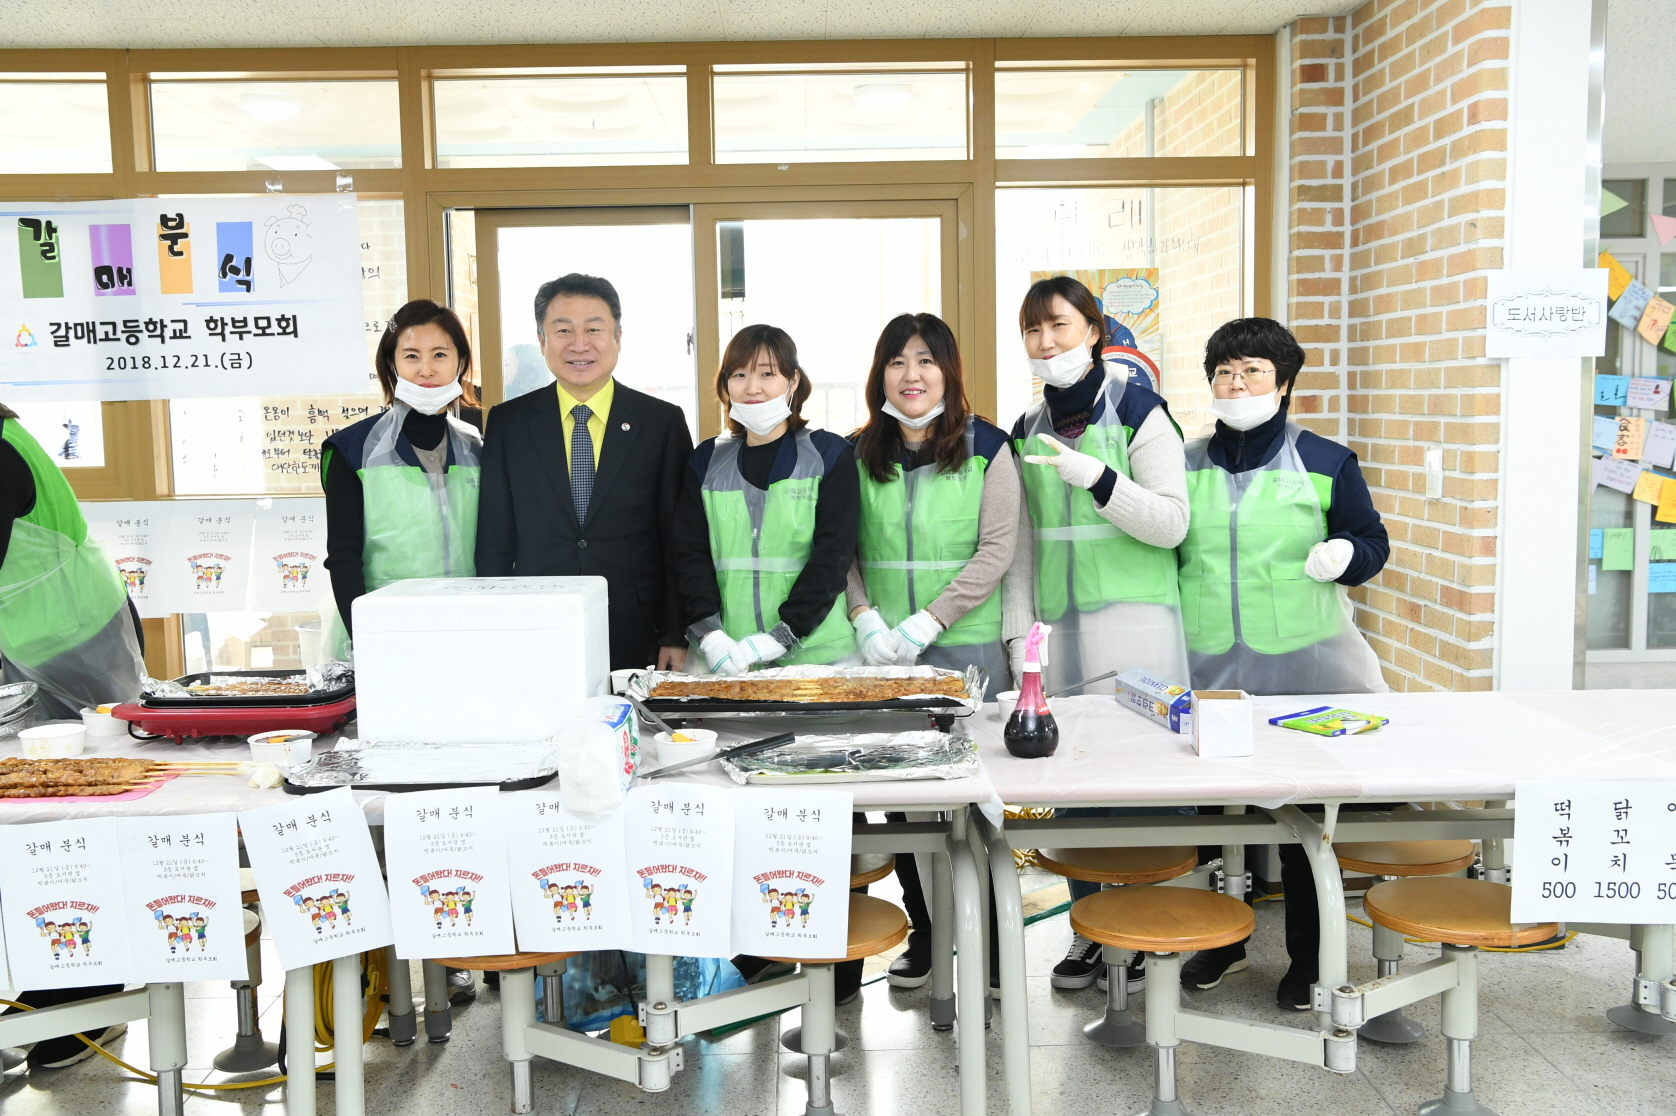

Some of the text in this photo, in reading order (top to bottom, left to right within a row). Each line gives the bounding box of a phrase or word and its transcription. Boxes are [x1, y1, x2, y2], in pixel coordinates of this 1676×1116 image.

[1507, 306, 1586, 322] 도서사랑반
[49, 314, 299, 347] 갈매고등학교 학부모회
[105, 351, 253, 371] 2018.12.21.(금)
[263, 406, 290, 421] 온몸이
[416, 805, 473, 822] 갈매 분식
[535, 802, 560, 816] 갈매
[650, 800, 704, 816] 갈매 분식
[764, 807, 820, 822] 갈매 분식
[272, 810, 331, 836] 갈매 분식
[147, 832, 204, 848] 갈매 분식
[1551, 799, 1573, 874] 떡볶이
[1608, 798, 1633, 874] 닭꼬치
[26, 837, 86, 856] 갈매 분식
[412, 869, 484, 887] 돈들어왔다! 지르자!!
[531, 862, 602, 880] 돈들어왔다! 지르자!!
[636, 864, 707, 883] 돈들어왔다! 지르자!!
[753, 870, 825, 887] 돈들어왔다! 지르자!!
[283, 873, 355, 897] 돈들어왔다! 지르자!!
[1541, 881, 1576, 899] 500
[1593, 881, 1641, 899] 1500
[26, 900, 100, 919] 돈들어왔다! 지르자!!
[145, 894, 217, 912] 돈들어왔다! 지르자!!
